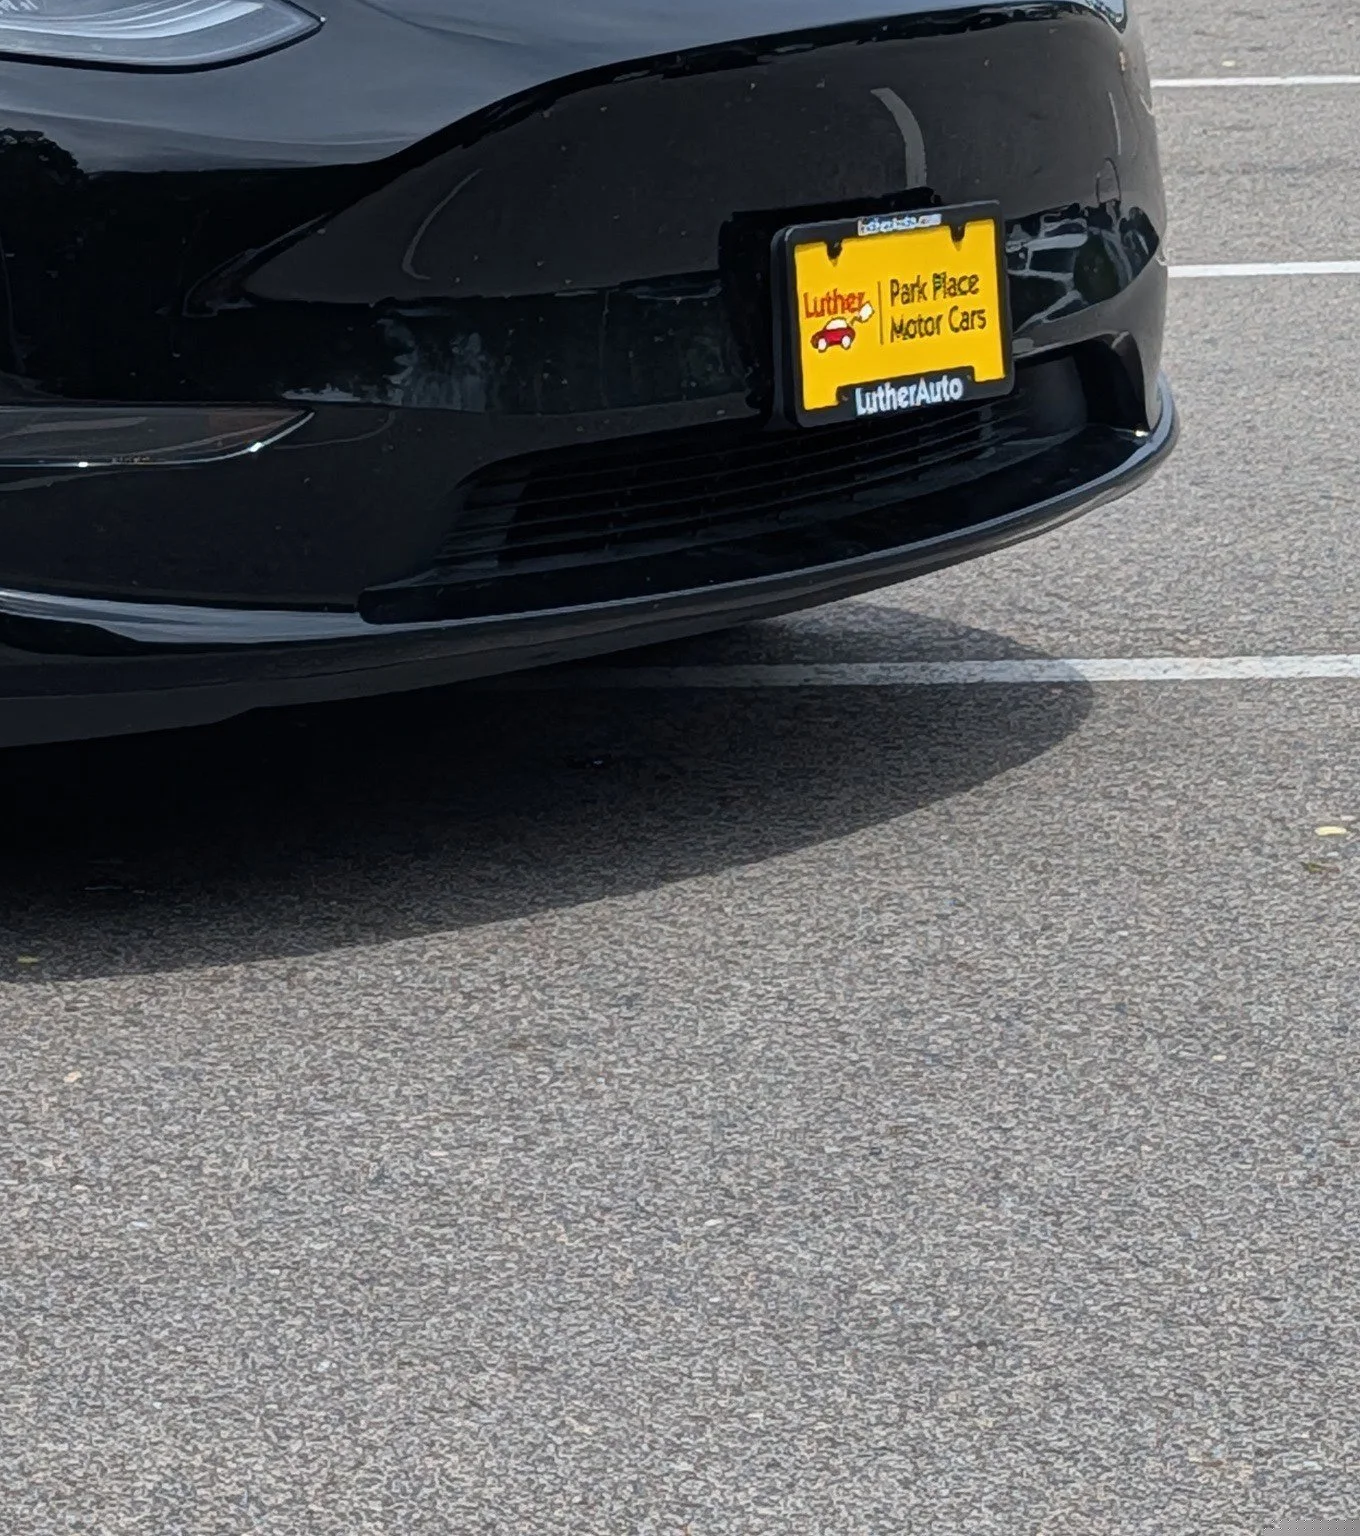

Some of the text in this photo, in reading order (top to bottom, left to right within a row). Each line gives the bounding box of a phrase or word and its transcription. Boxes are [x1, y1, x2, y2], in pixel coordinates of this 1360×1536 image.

[803, 288, 865, 318] Luther
[890, 271, 979, 306] Park Place
[890, 305, 986, 343] Motor Cars
[855, 376, 963, 415] LutherAuto
